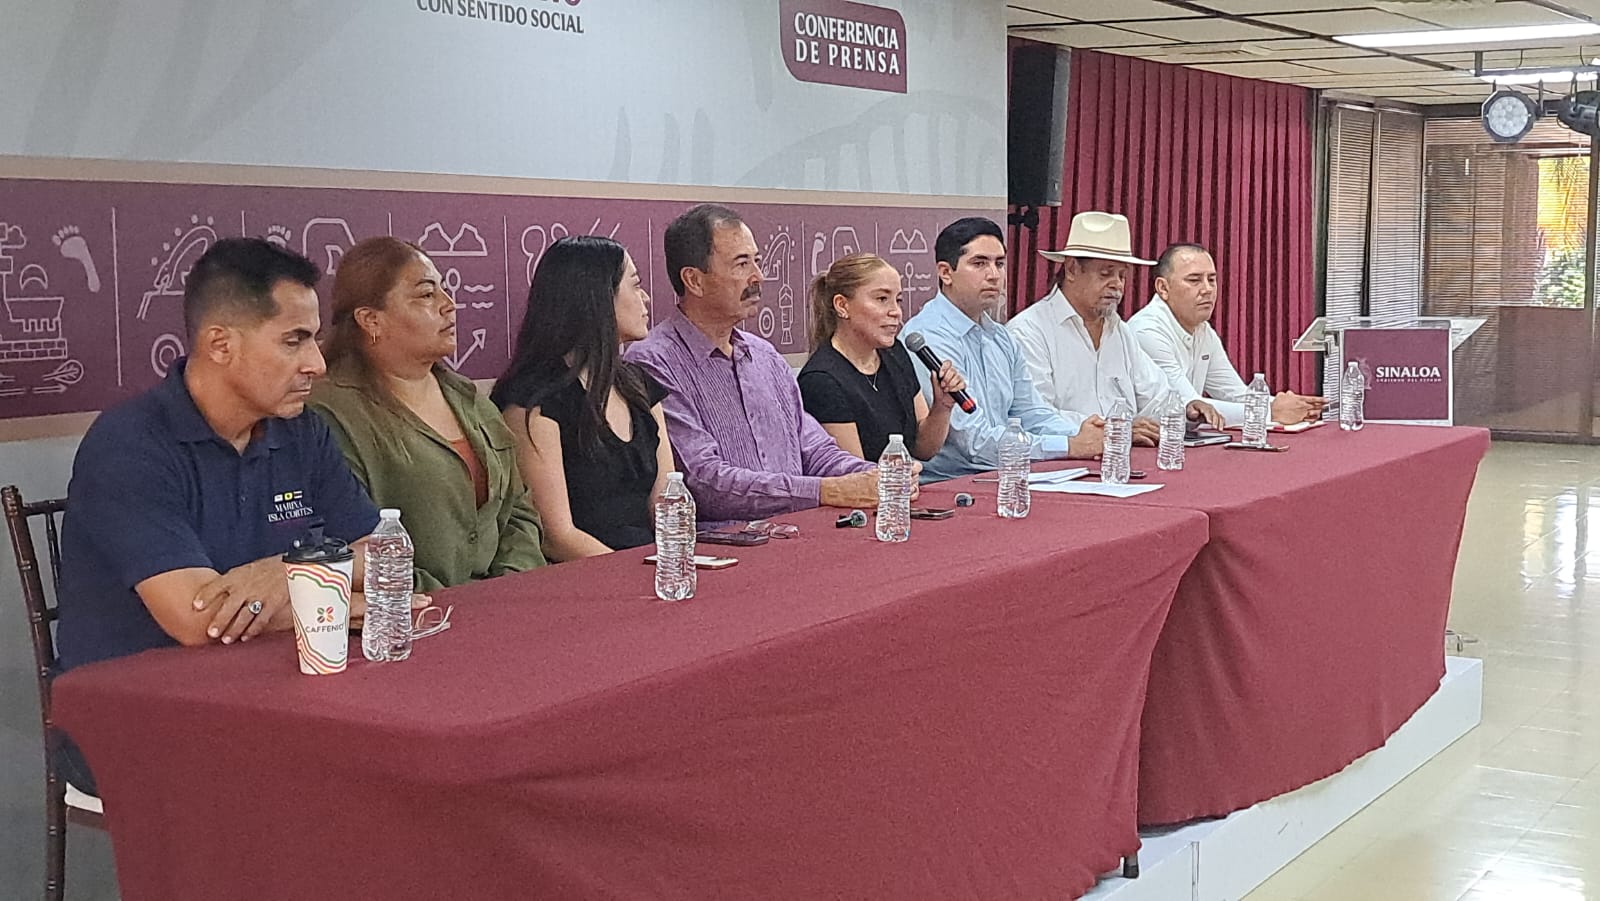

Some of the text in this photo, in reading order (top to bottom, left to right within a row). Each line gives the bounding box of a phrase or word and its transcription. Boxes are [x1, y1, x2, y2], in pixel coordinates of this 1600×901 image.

[417, 0, 584, 33] CON SENTIDO SOCIAL
[794, 12, 899, 50] CONFERENCIA
[796, 39, 899, 75] DE PRENSA
[1376, 366, 1440, 378] SINALOA
[268, 512, 285, 522] ISLA
[305, 623, 344, 633] CAFFENIO
